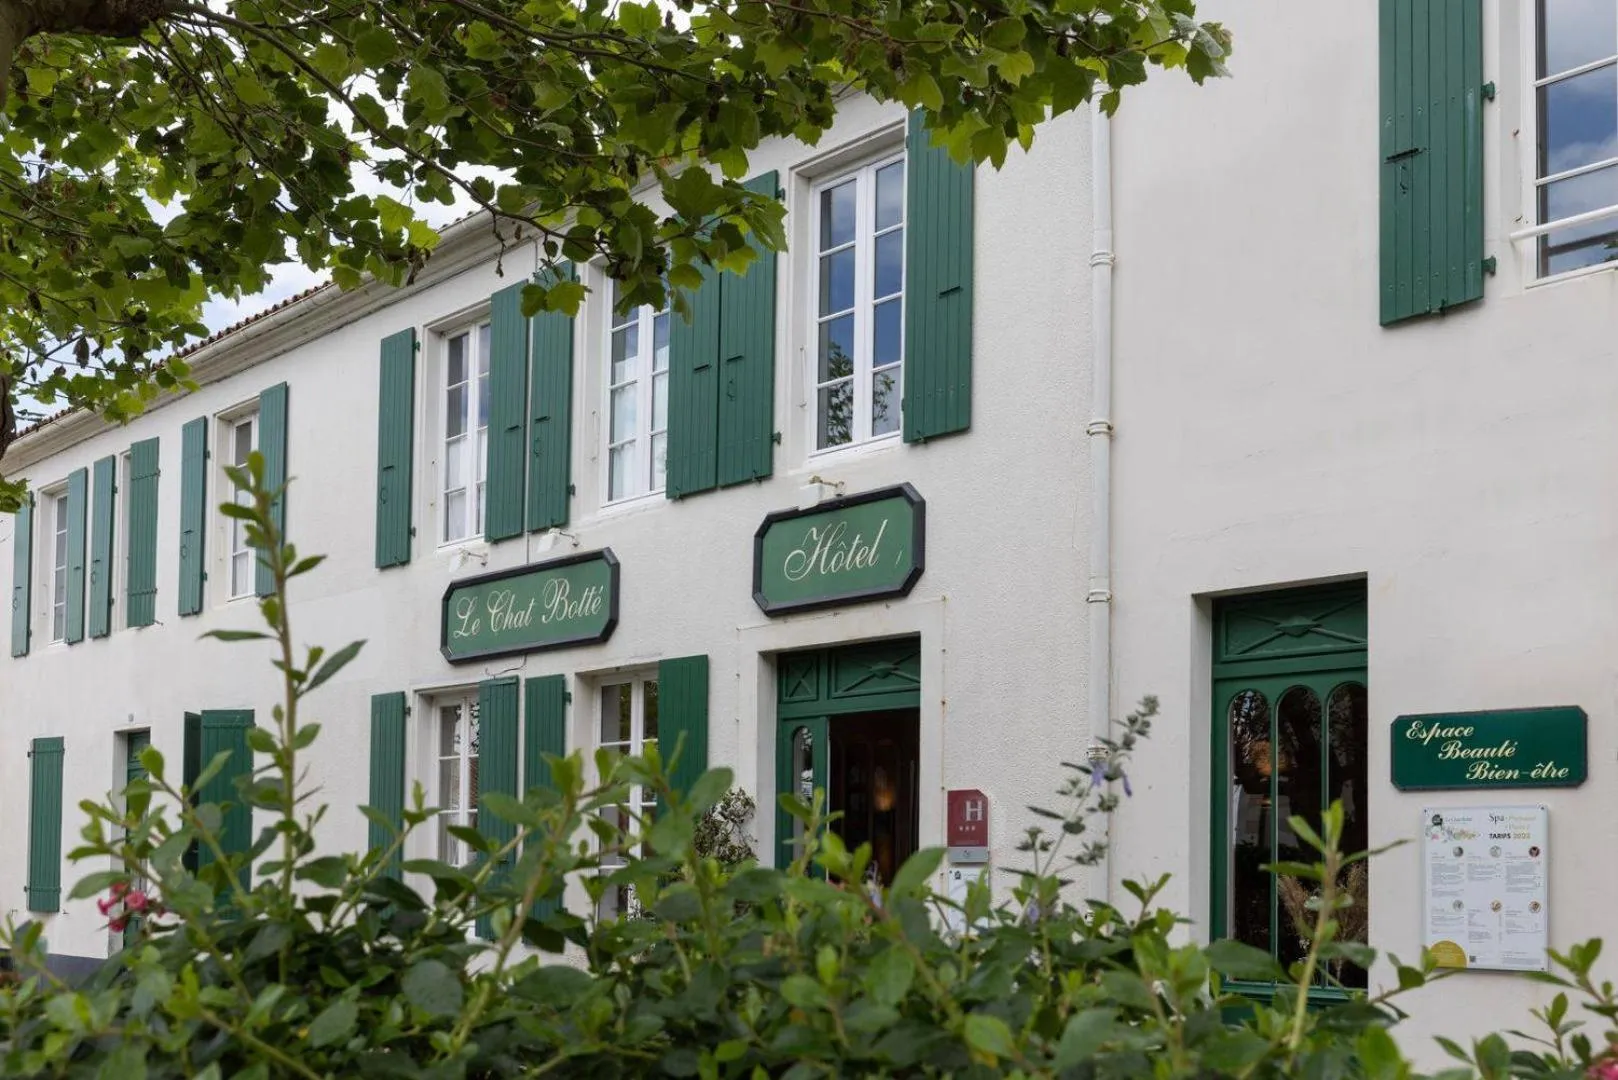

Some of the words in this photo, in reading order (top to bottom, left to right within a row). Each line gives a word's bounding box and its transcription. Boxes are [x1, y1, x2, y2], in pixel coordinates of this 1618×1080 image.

[784, 519, 888, 581] Hôtel
[453, 596, 481, 638] Le
[487, 589, 535, 632] Chat
[542, 578, 604, 624] Botté
[1405, 720, 1475, 746] Espace
[1438, 740, 1518, 760] Beauté
[1466, 760, 1570, 780] Bien-être
[964, 800, 983, 821] H
[1488, 814, 1505, 824] Spa
[1488, 832, 1512, 840] TARIFS
